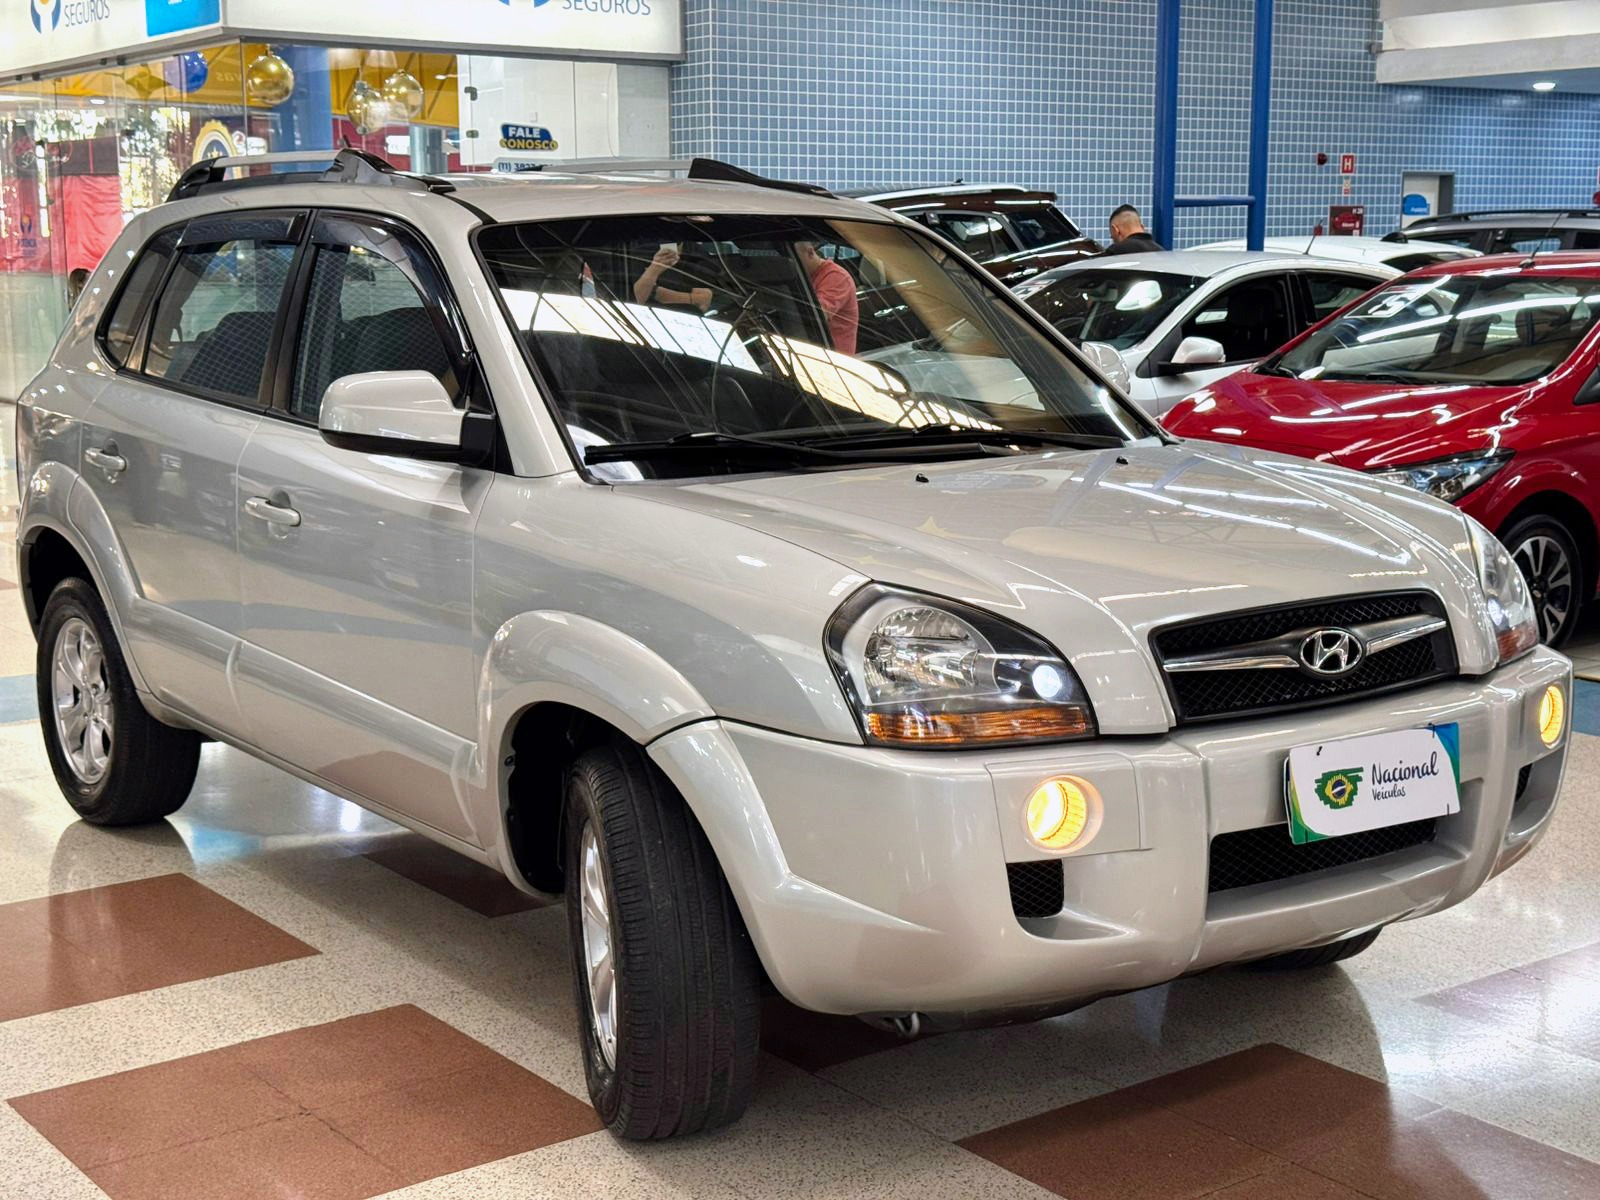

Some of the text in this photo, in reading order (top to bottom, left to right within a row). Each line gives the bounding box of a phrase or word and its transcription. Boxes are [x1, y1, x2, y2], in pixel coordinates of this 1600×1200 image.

[64, 0, 110, 27] SEGUROS
[508, 126, 540, 137] FALE
[499, 138, 559, 151] CONOSCO
[1344, 157, 1352, 171] H
[1372, 751, 1439, 785] Nacional
